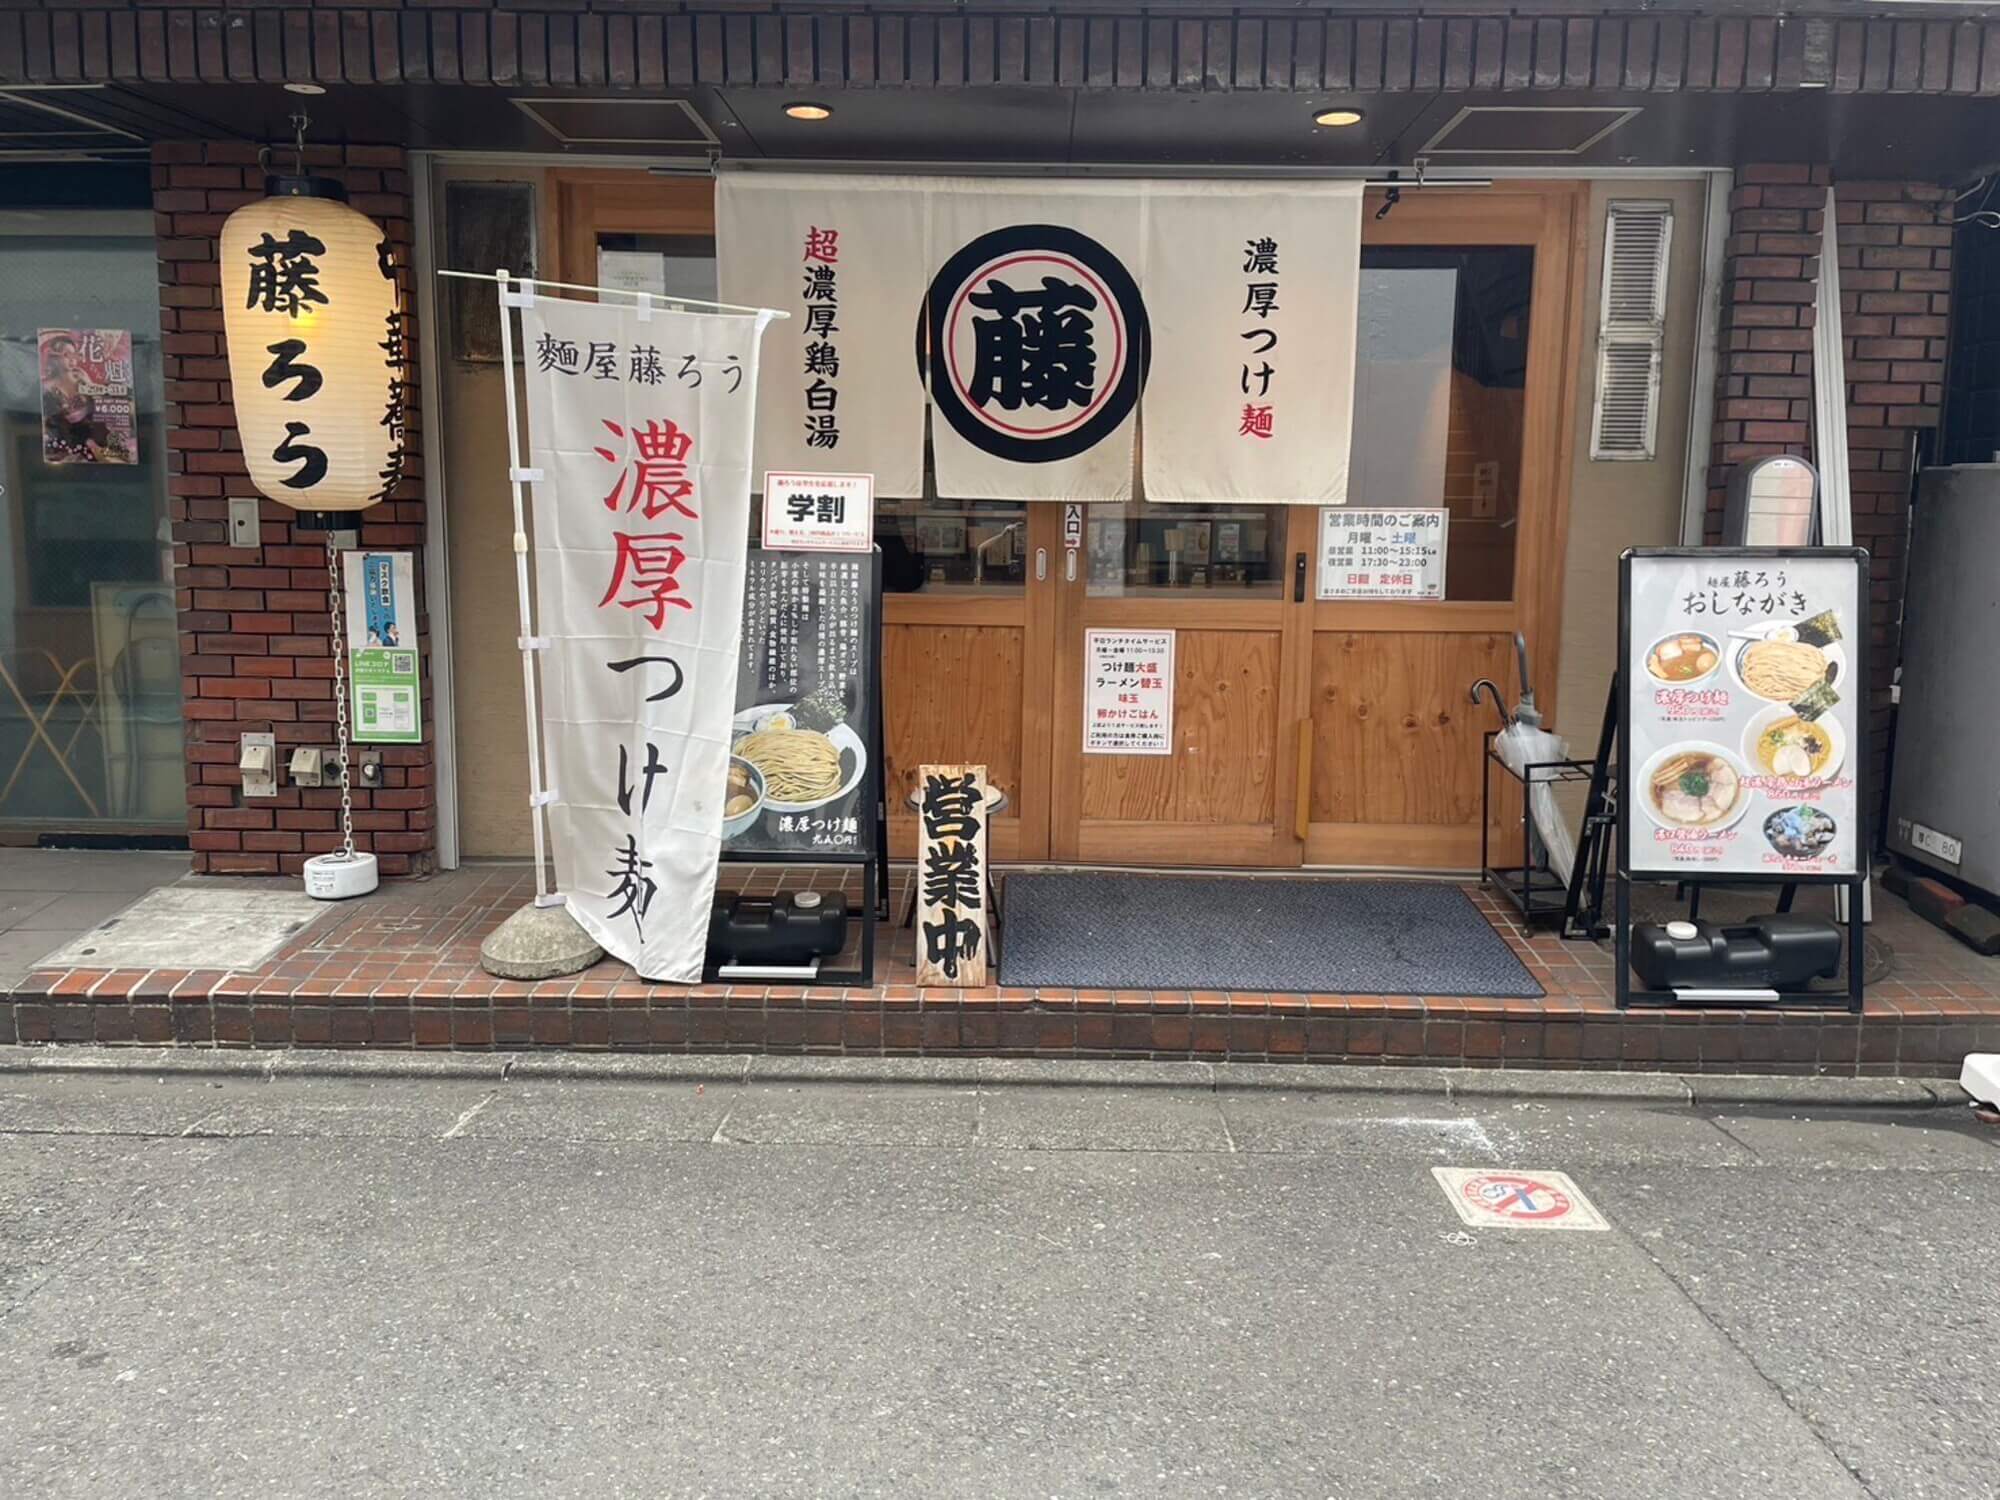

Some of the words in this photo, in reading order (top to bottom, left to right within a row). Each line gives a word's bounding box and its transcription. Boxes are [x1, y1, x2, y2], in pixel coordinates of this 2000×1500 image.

[803, 225, 841, 449] 超濃厚鶏白湯
[967, 277, 1099, 411] 藤
[1239, 236, 1281, 440] 濃厚つけ麺
[246, 229, 329, 489] 藤ろう
[786, 493, 846, 524] 学割
[1067, 504, 1081, 534] 入口
[1328, 513, 1440, 527] 営業時間のご案内
[1380, 573, 1413, 585] 定休日
[1682, 589, 1808, 616] おしながき
[1101, 661, 1159, 673] つけ麺大盛
[1096, 677, 1164, 689] ラーメン替玉
[1118, 693, 1139, 704] 味玉
[779, 815, 859, 834] 濃厚つけ麺
[922, 772, 983, 980] 営業中
